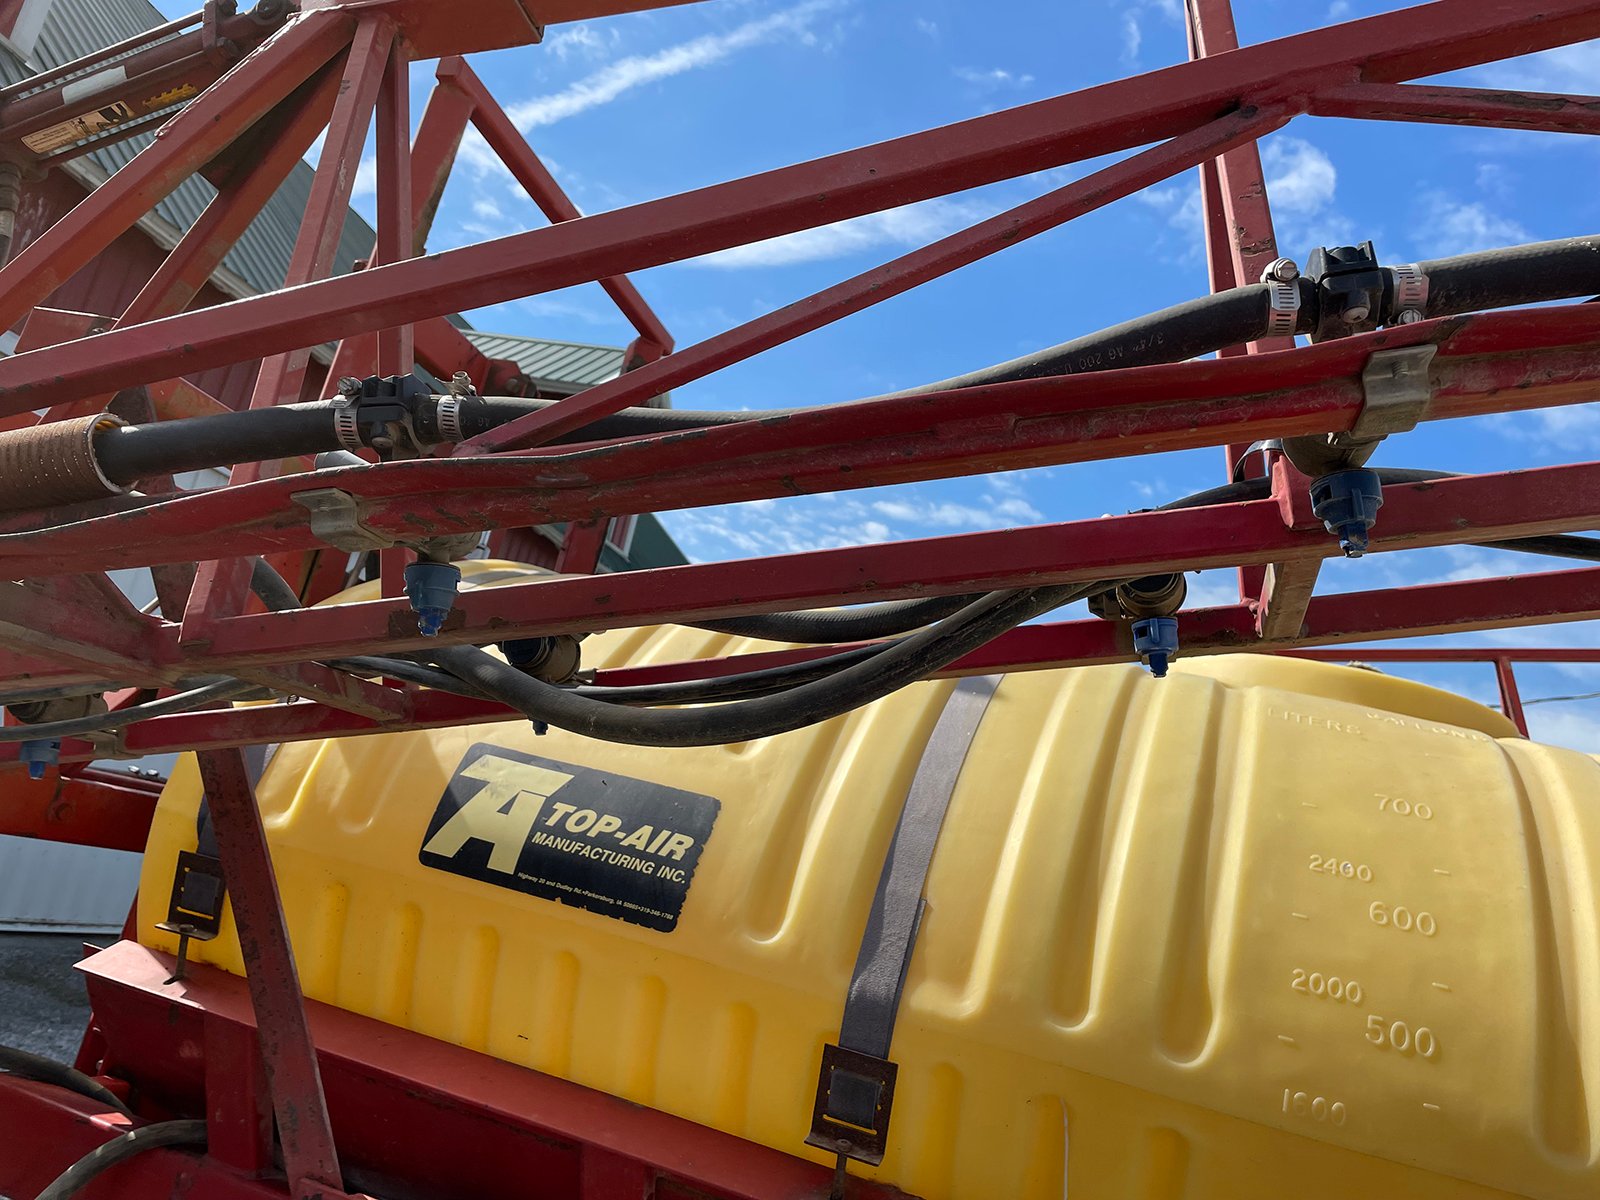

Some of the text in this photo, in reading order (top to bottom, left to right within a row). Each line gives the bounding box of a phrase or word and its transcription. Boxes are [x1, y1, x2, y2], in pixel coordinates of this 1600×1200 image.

[1078, 352, 1102, 370] 200
[1267, 707, 1362, 735] LITERS
[1374, 793, 1434, 821] 700
[544, 802, 695, 861] TOP-AIR
[531, 831, 687, 884] MANUFACTURING INC.
[1308, 853, 1373, 883] 2400
[517, 872, 538, 883] Highway
[1369, 900, 1438, 937] 600
[1290, 968, 1362, 1004] 2000
[1364, 1014, 1436, 1058] 500
[1281, 1088, 1347, 1127] 1600
